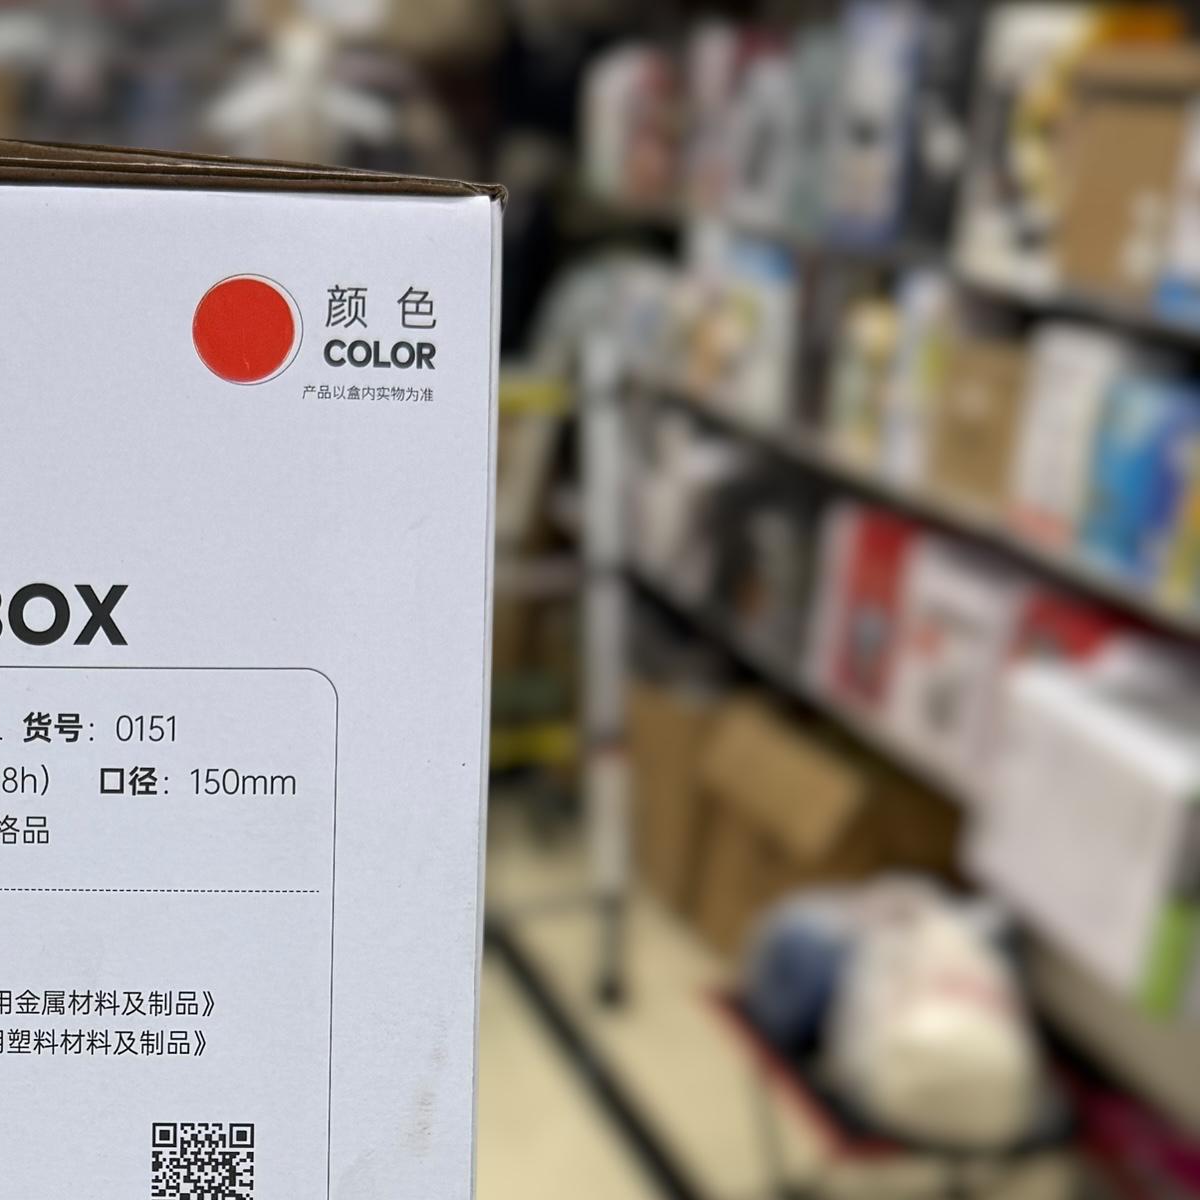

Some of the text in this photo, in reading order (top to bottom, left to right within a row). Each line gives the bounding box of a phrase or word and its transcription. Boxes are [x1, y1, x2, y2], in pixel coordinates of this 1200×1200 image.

[323, 338, 437, 370] COLOR
[302, 384, 434, 402] 产品以盒内实物为准
[115, 714, 176, 743] 0151
[190, 767, 297, 796] 150mm
